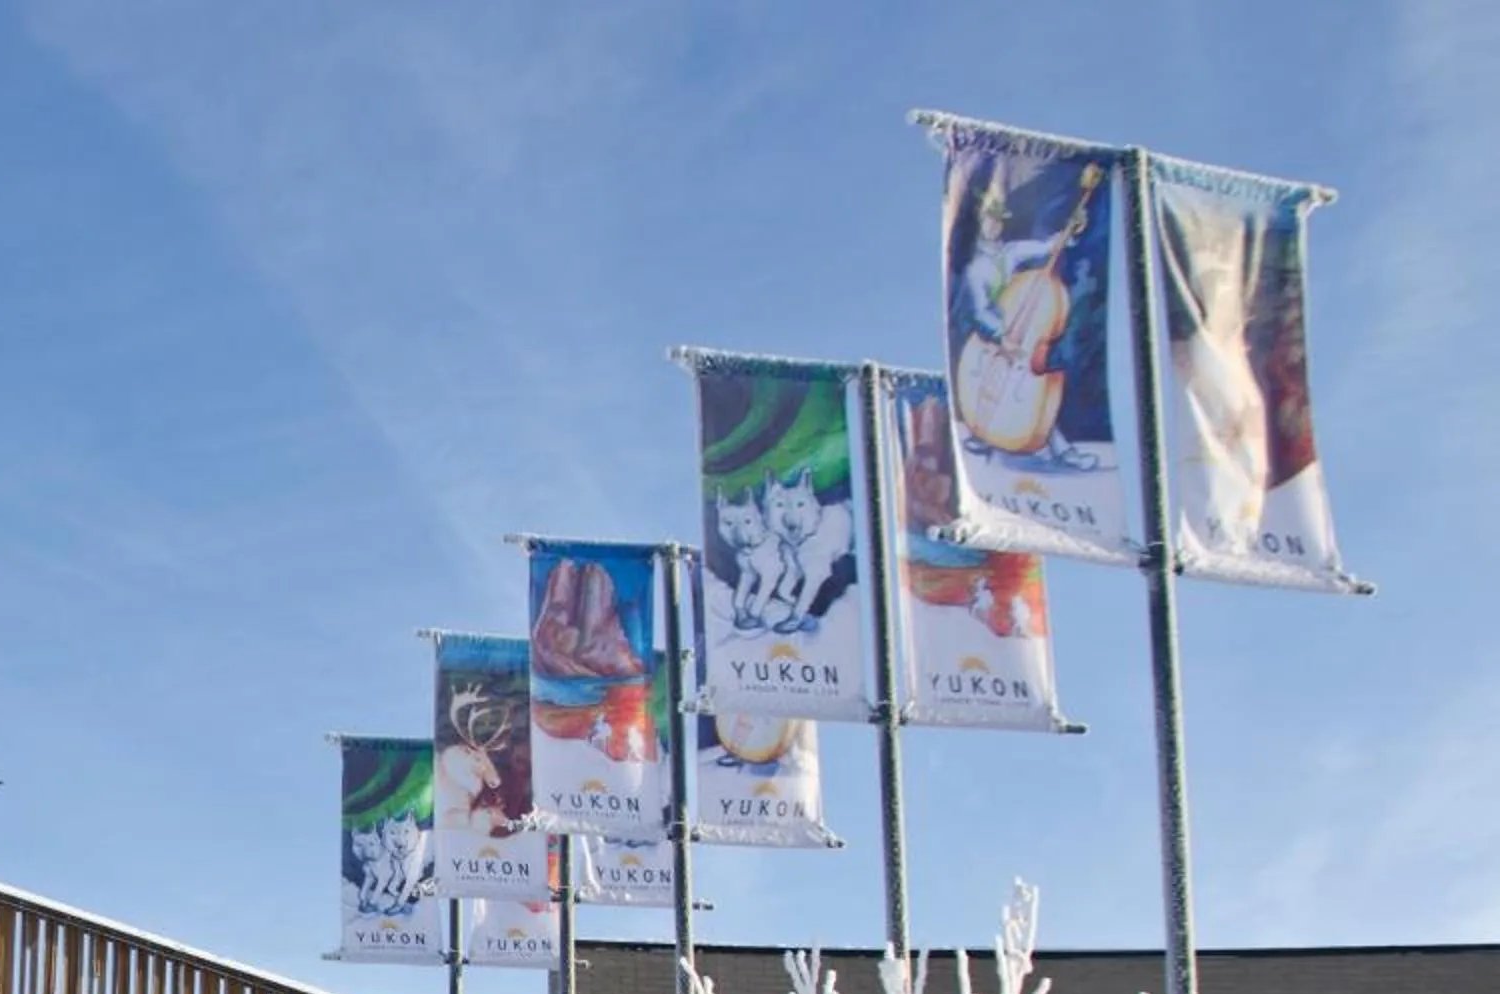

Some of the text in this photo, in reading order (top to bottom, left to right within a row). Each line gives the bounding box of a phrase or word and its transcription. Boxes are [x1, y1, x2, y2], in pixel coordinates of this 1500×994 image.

[980, 492, 1096, 526] YUKON
[1204, 516, 1306, 556] YON
[731, 660, 840, 685] YUKON
[929, 672, 1030, 699] YUKON
[551, 793, 640, 813] YUKON
[719, 799, 806, 818] YUKON
[452, 858, 530, 877] YUKON
[595, 865, 672, 884] YUKON
[356, 931, 426, 946] YUKON
[486, 937, 552, 951] YUKON
